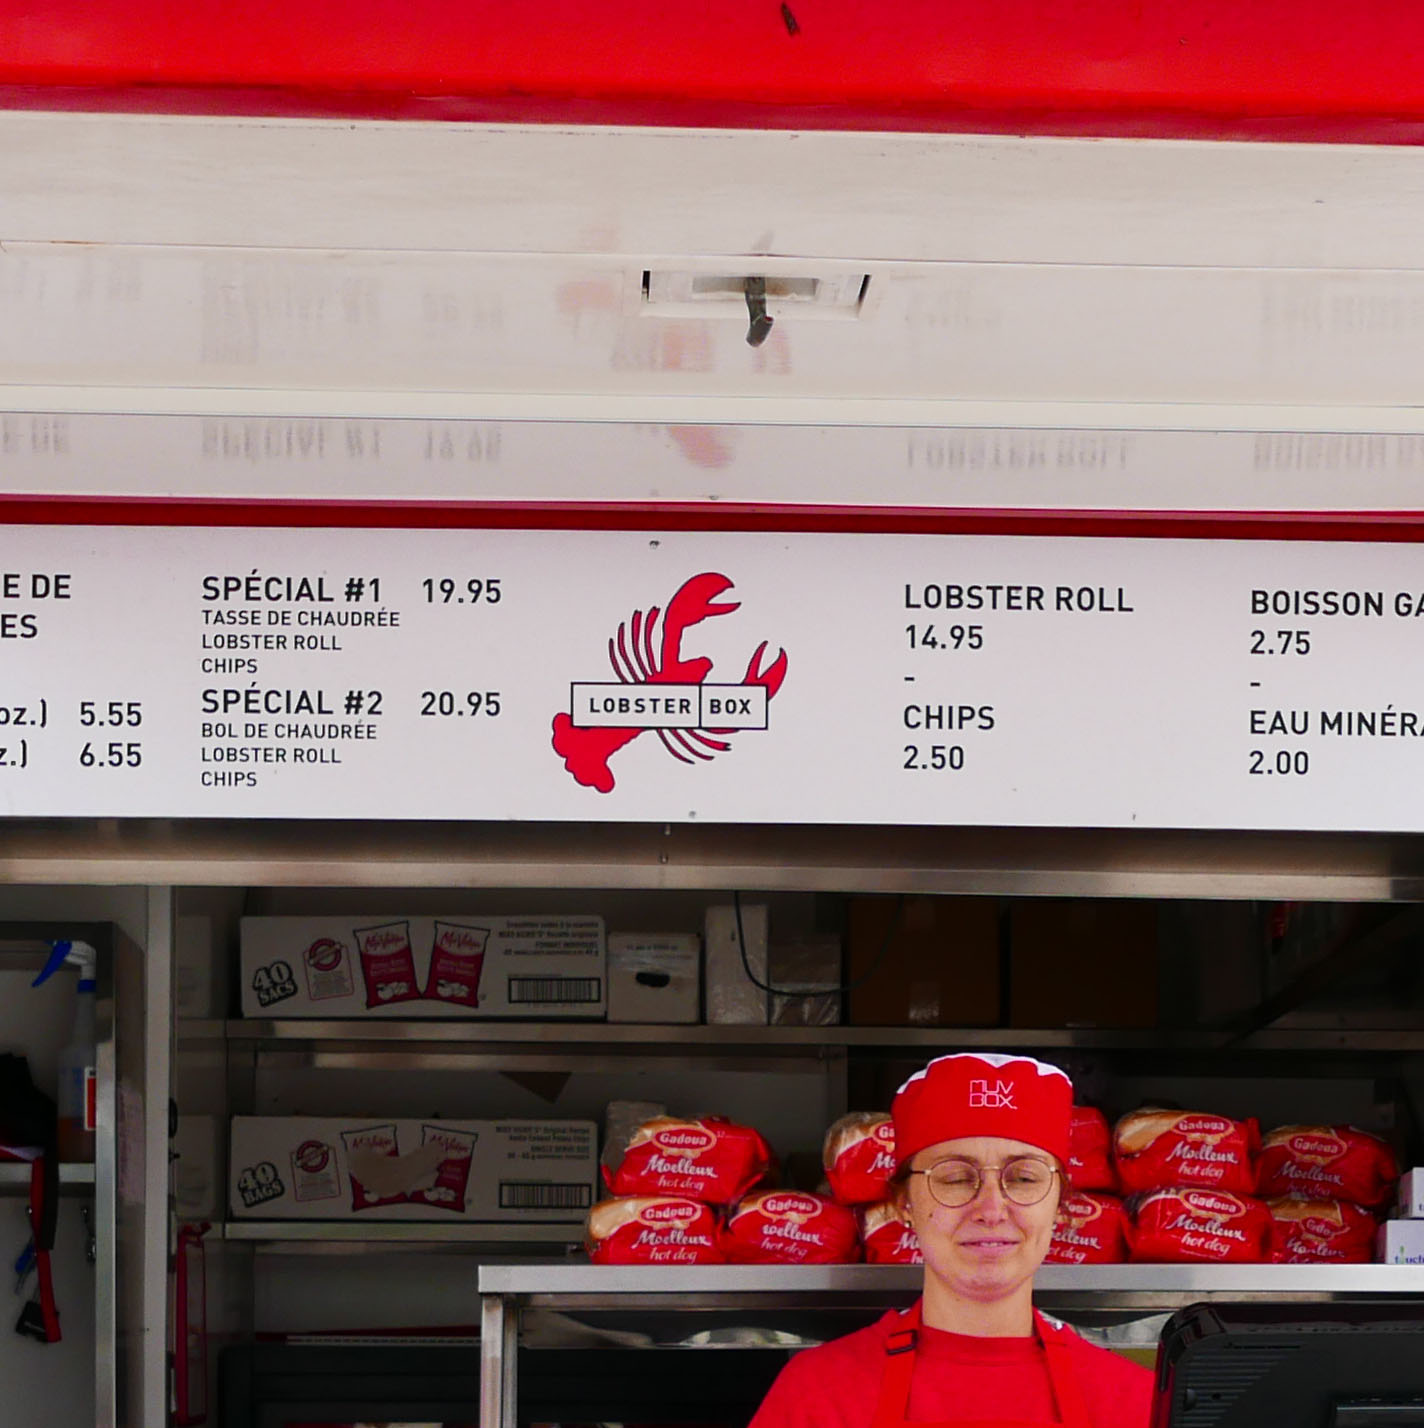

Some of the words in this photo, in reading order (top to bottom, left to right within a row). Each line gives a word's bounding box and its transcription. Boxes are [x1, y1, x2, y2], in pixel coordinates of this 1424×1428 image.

[31, 574, 72, 599] DE
[202, 568, 335, 602] SPÉCIAL
[344, 577, 380, 603] #1
[422, 578, 501, 604] 19.95
[905, 584, 1044, 611] LOBSTER
[1055, 586, 1134, 612] ROLL
[1251, 589, 1383, 617] BOISSON
[201, 609, 262, 626] TASSE
[267, 610, 292, 626] DE
[297, 605, 400, 627] CHAUDRÉE
[202, 633, 287, 650] LOBSTER
[294, 634, 342, 651] ROLL
[906, 624, 983, 650] 14.95
[1250, 629, 1311, 655] 2.75
[201, 658, 258, 674] CHIPS
[202, 681, 334, 715] SPÉCIAL
[344, 690, 383, 716] #2
[420, 691, 501, 717] 20.95
[589, 697, 691, 714] LOBSTER
[709, 698, 751, 715] BOX
[80, 701, 142, 727] 5.55
[903, 704, 995, 731] CHIPS
[1250, 710, 1309, 735] EAU
[201, 722, 238, 738] BOL
[244, 723, 268, 739] DE
[274, 718, 377, 740] CHAUDRÉE
[79, 742, 142, 768] 6.55
[201, 747, 287, 763] LOBSTER
[293, 747, 342, 764] ROLL
[903, 745, 964, 770] 2.50
[1249, 750, 1309, 775] 2.00
[201, 771, 257, 787] CHIPS
[253, 962, 292, 990] 40
[970, 1093, 1014, 1108] BOX
[1178, 1119, 1227, 1132] Gadoua
[659, 1133, 708, 1146] Gadoua
[640, 1154, 718, 1178] Moelleux
[1178, 1161, 1199, 1176] hot
[1200, 1163, 1225, 1179] dog
[645, 1205, 694, 1219] Gadoua
[766, 1198, 814, 1212] Gadoua
[1188, 1193, 1237, 1213] Gadoua
[631, 1229, 712, 1249] Moelleux
[1165, 1214, 1247, 1241] Moelleux
[649, 1247, 672, 1261] hot
[673, 1248, 698, 1265] dog
[1181, 1232, 1205, 1249] hot
[1205, 1236, 1231, 1256] dog
